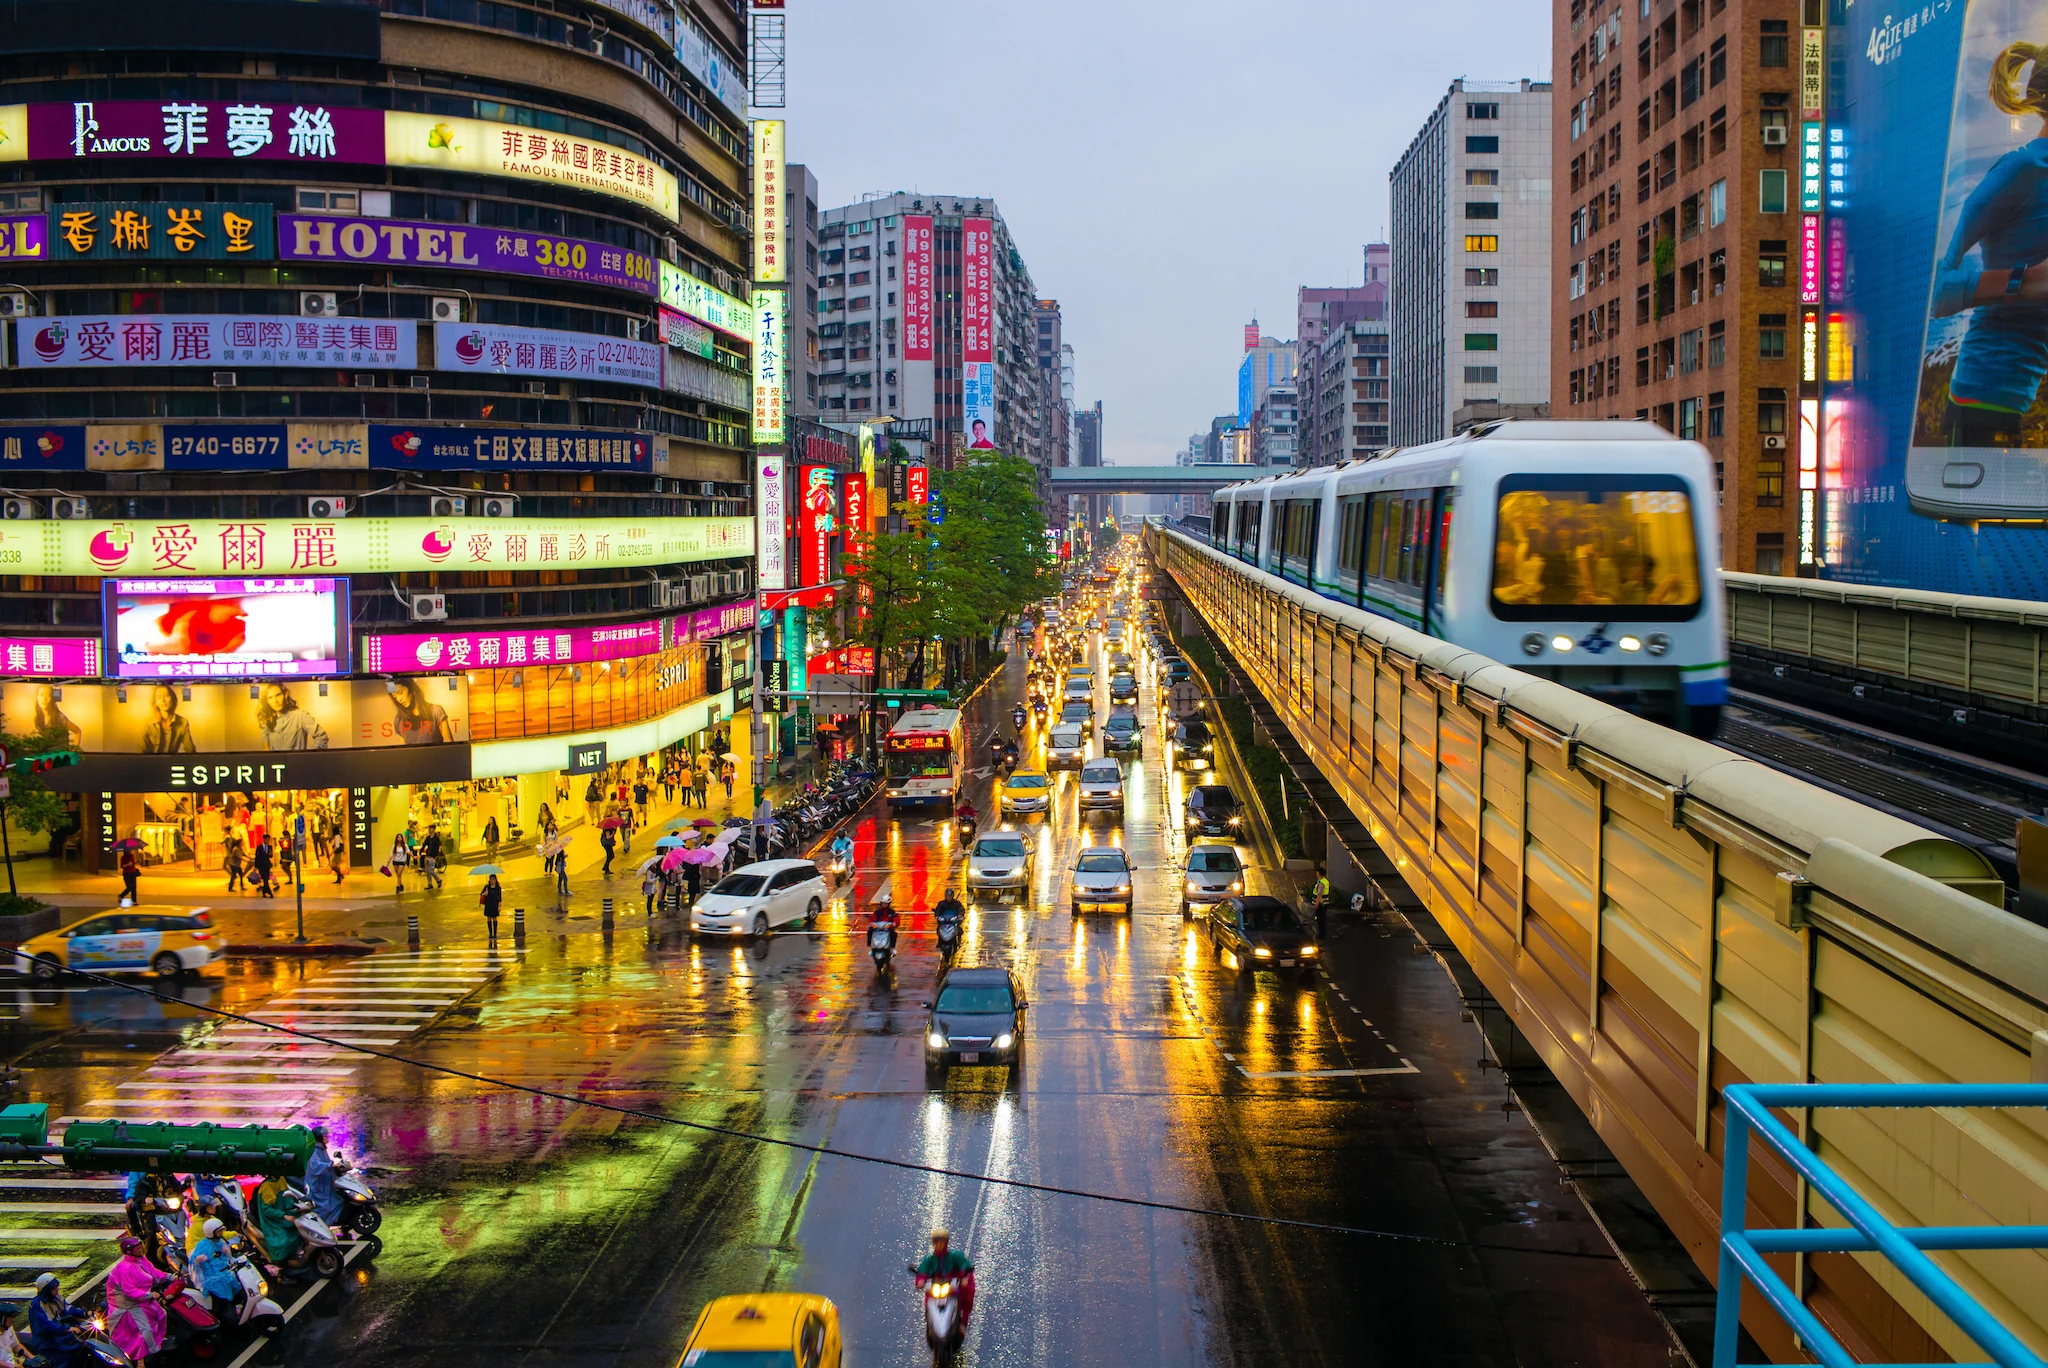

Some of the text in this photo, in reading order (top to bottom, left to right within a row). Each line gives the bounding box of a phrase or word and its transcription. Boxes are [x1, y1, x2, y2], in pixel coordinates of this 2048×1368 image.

[161, 102, 337, 159] 菲夢絲
[502, 130, 655, 191] 菲夢絲國際美容機構
[503, 161, 655, 203] FAMOUS INTERNATIONAL BEAUTY
[764, 159, 776, 266] 菲夢絲國際美容機構
[60, 207, 255, 253] 香榭峇里
[293, 220, 479, 266] HOTEL
[495, 235, 528, 257] 休息
[535, 239, 587, 270] 380
[601, 250, 622, 272] 住宿
[624, 252, 652, 282] 880
[1802, 291, 1817, 302] 6/F
[77, 321, 211, 362] 愛爾麗
[223, 349, 397, 364] 醫學美容專業領導品牌
[490, 340, 596, 374] 愛爾麗診所
[598, 342, 656, 368] 02-2740-2338
[4, 436, 22, 460] 心
[113, 438, 157, 457] しちだ
[171, 435, 280, 456] 2740-6677
[317, 437, 362, 456] しちだ
[433, 435, 632, 464] 台北市私立 七田文理語文短期補習班
[765, 484, 780, 570] 愛爾麗診所
[848, 480, 861, 541] TASTY
[152, 523, 338, 571] 愛爾麗
[468, 533, 610, 563] 愛爾麗診所
[618, 543, 653, 557] 02-2740-2338
[0, 643, 53, 672] 集團
[448, 633, 572, 667] 愛爾麗集團
[361, 718, 461, 739] ESPRIT
[171, 763, 287, 785] ESPRIT
[579, 750, 602, 767] NET
[101, 791, 112, 854] ESPRIT
[354, 787, 366, 850] ESPRIT
